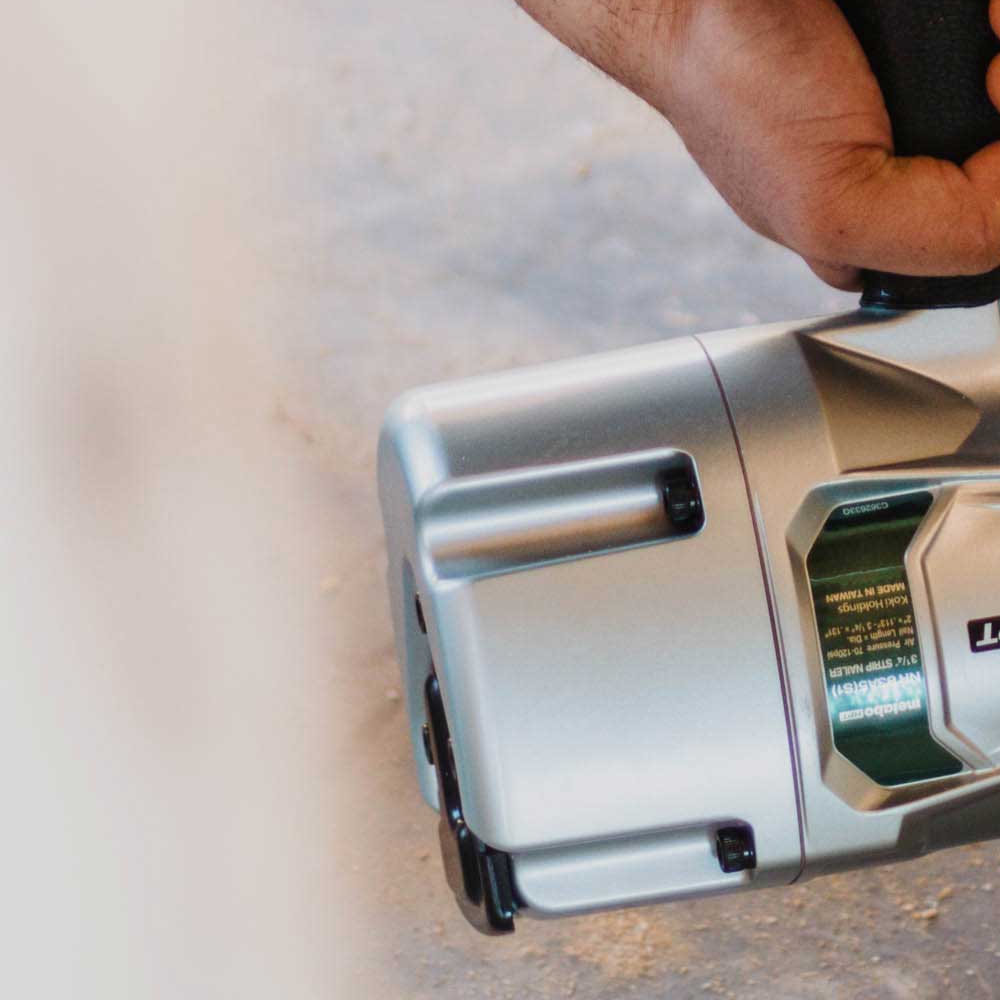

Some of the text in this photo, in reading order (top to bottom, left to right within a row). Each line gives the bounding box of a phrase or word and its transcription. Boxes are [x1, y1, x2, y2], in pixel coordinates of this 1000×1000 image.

[825, 582, 905, 603] MADE IN TAIWAN
[838, 595, 908, 614] Koki Holdings
[870, 628, 896, 640] Length
[867, 640, 901, 652] Pressure
[829, 664, 864, 678] NAILER
[865, 658, 893, 671] STRIP
[864, 700, 921, 718] metabo
